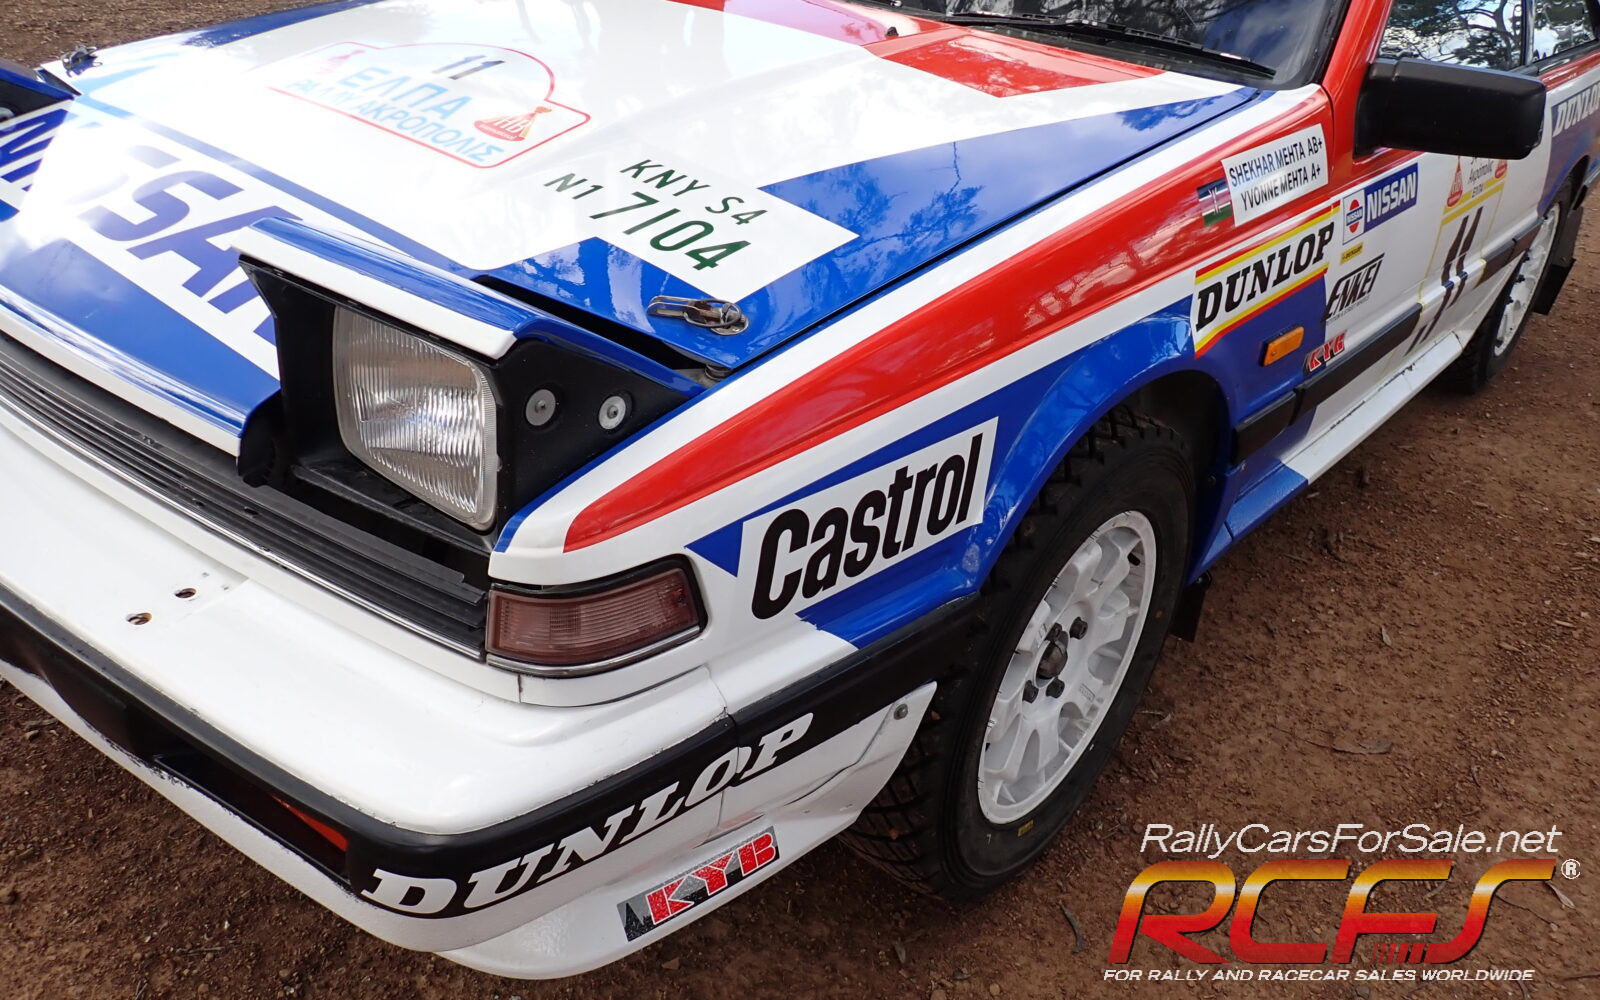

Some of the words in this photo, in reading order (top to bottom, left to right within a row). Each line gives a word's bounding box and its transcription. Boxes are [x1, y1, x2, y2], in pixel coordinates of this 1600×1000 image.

[1551, 81, 1600, 137] DUNLO
[543, 173, 604, 200] N1
[619, 159, 711, 197] KNY
[704, 196, 768, 226] S4
[1229, 152, 1275, 187] SHEKHAR
[1276, 142, 1306, 169] MEHTA
[1307, 136, 1323, 156] AB+
[1240, 178, 1279, 211] YVONNE
[1280, 170, 1309, 193] MEHTA
[1310, 163, 1321, 182] A+
[1367, 172, 1416, 223] NISSAN
[1196, 222, 1335, 332] DUNLOP
[1321, 252, 1386, 322] ENKEI
[751, 432, 984, 621] Castrol
[360, 712, 815, 915] DUNLOP
[645, 831, 778, 925] KYB
